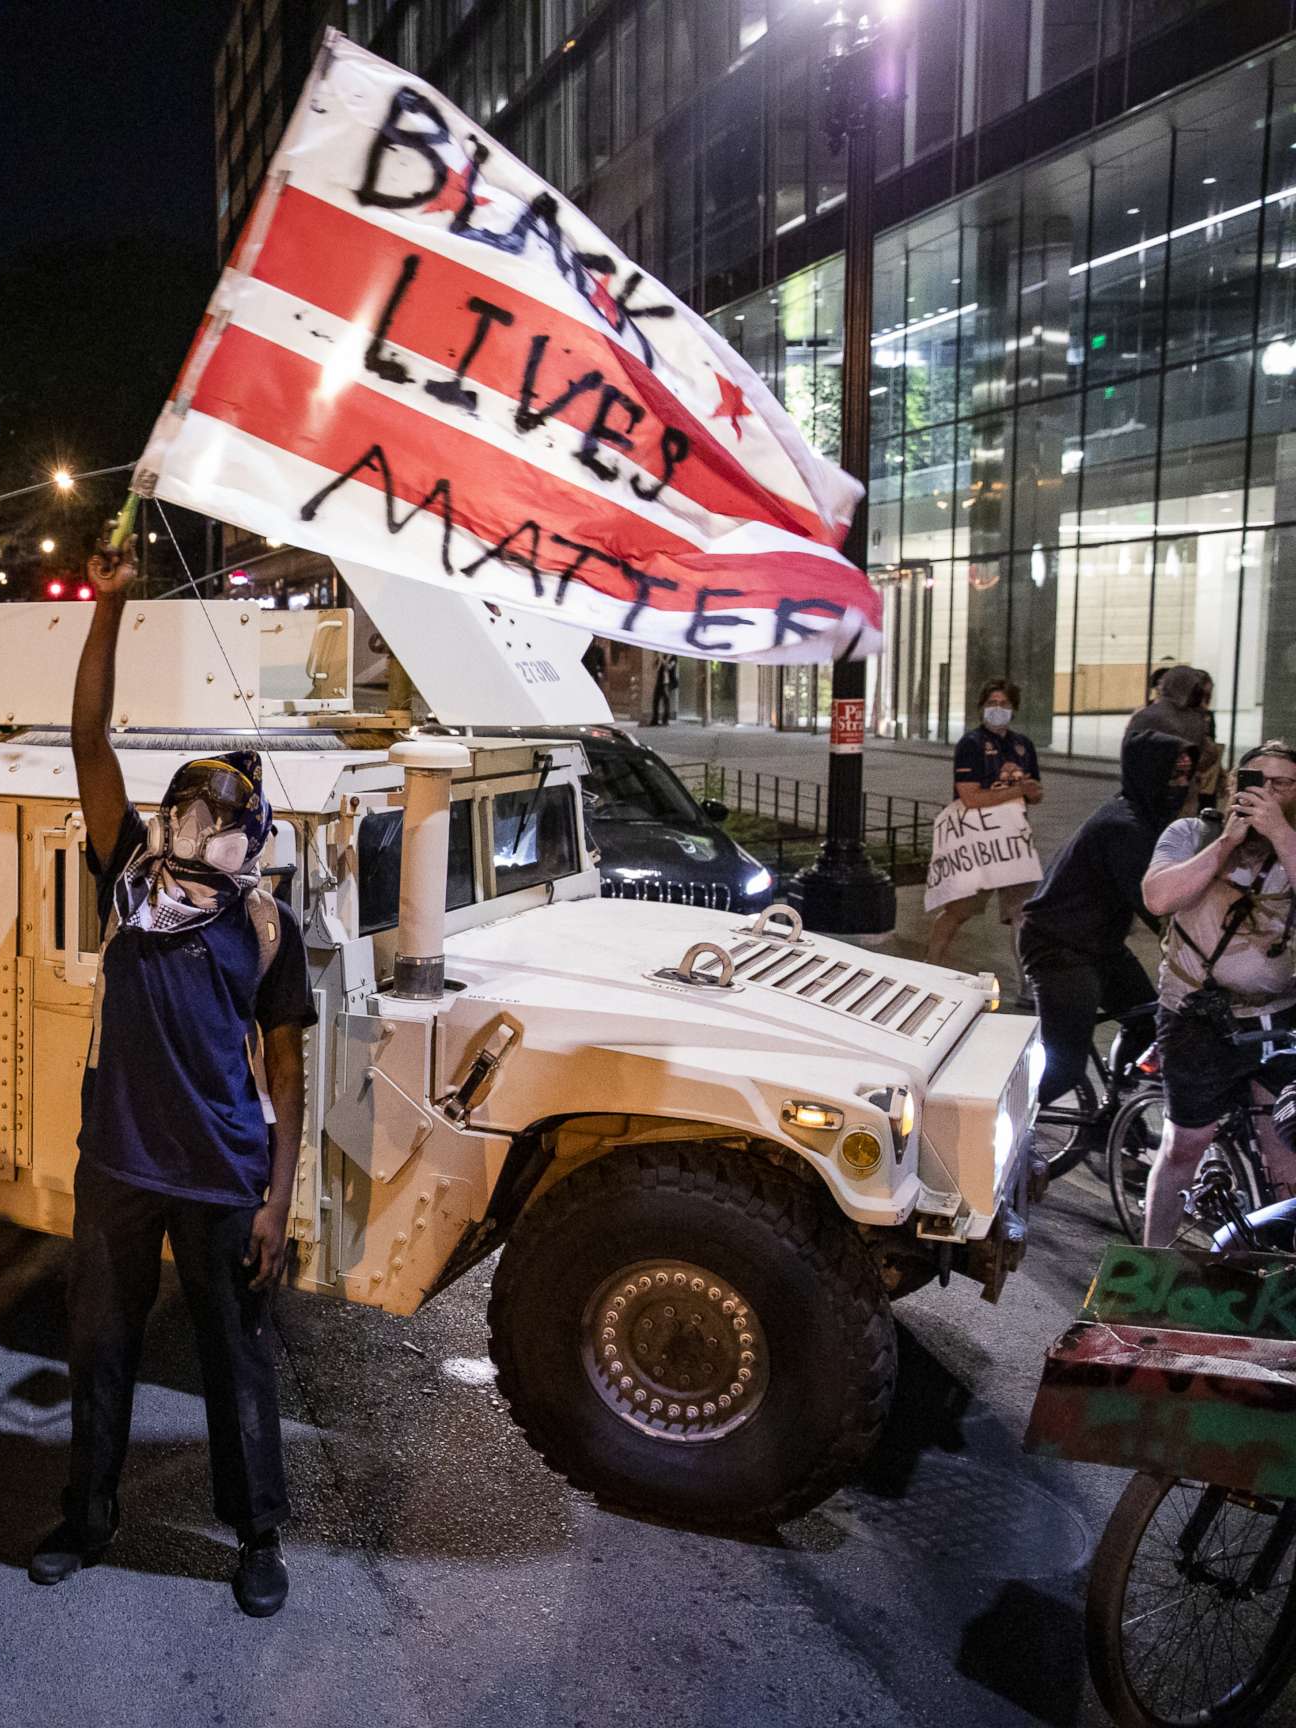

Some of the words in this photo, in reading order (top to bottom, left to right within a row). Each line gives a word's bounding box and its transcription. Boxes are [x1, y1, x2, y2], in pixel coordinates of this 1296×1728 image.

[365, 253, 690, 501] LIVES
[301, 444, 852, 652] MATTER
[935, 807, 1000, 847] TAKE
